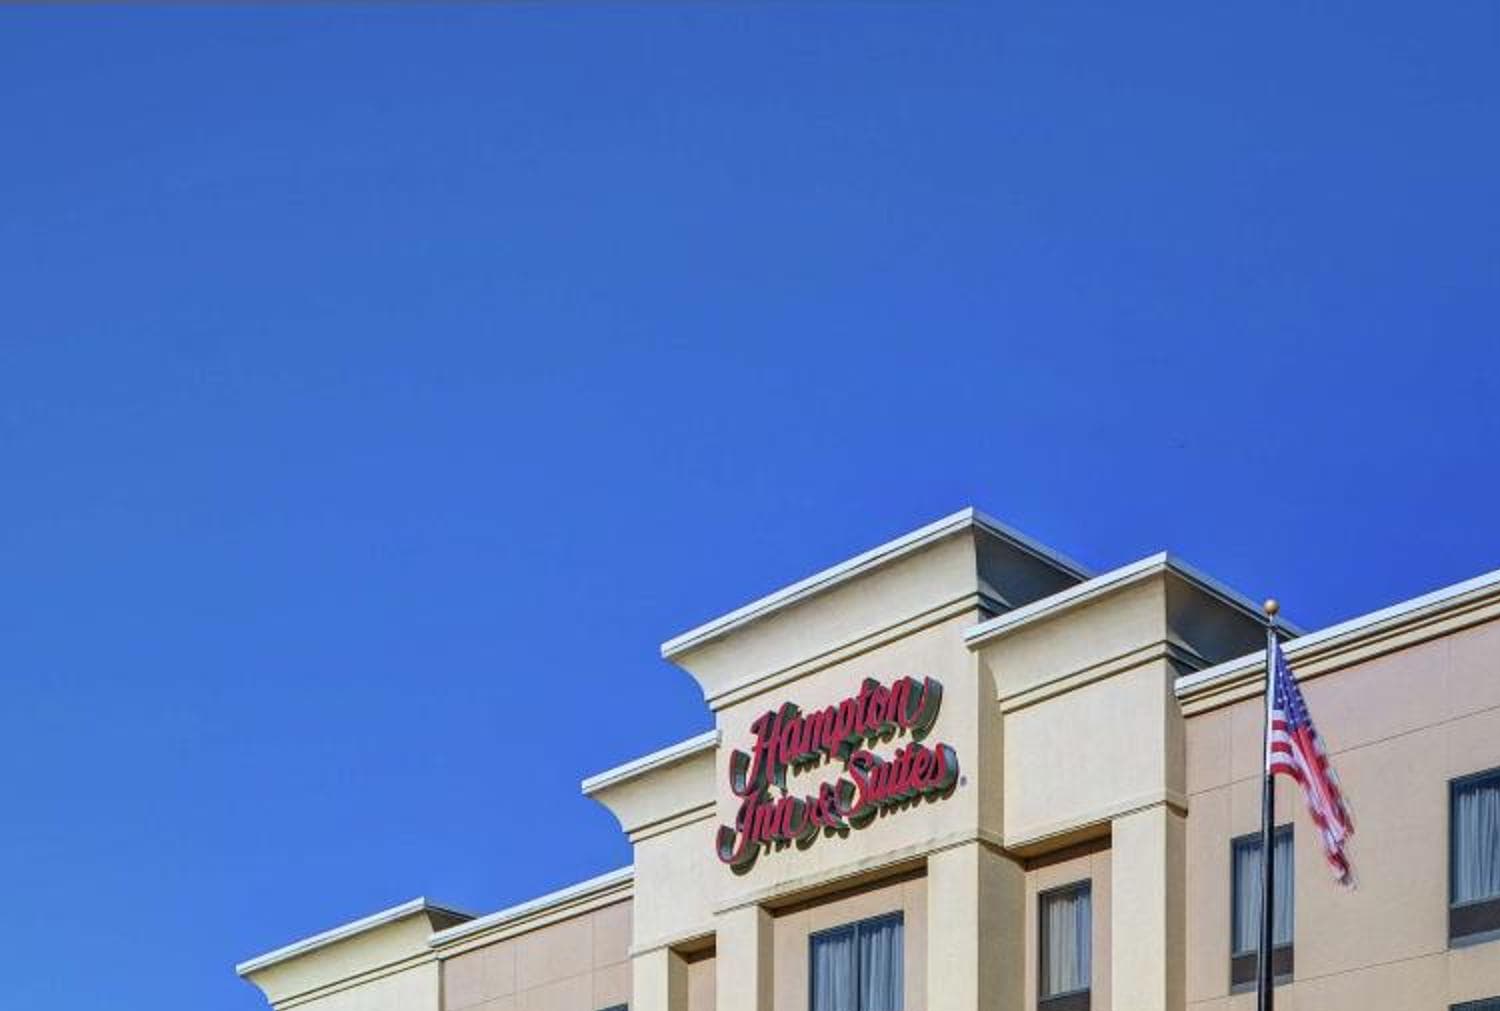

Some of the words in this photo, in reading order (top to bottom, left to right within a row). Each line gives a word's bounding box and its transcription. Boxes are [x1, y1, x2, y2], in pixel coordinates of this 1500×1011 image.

[730, 676, 943, 796] Hampton
[716, 794, 820, 876] Inn
[813, 780, 851, 839] &
[834, 741, 960, 830] Suites
